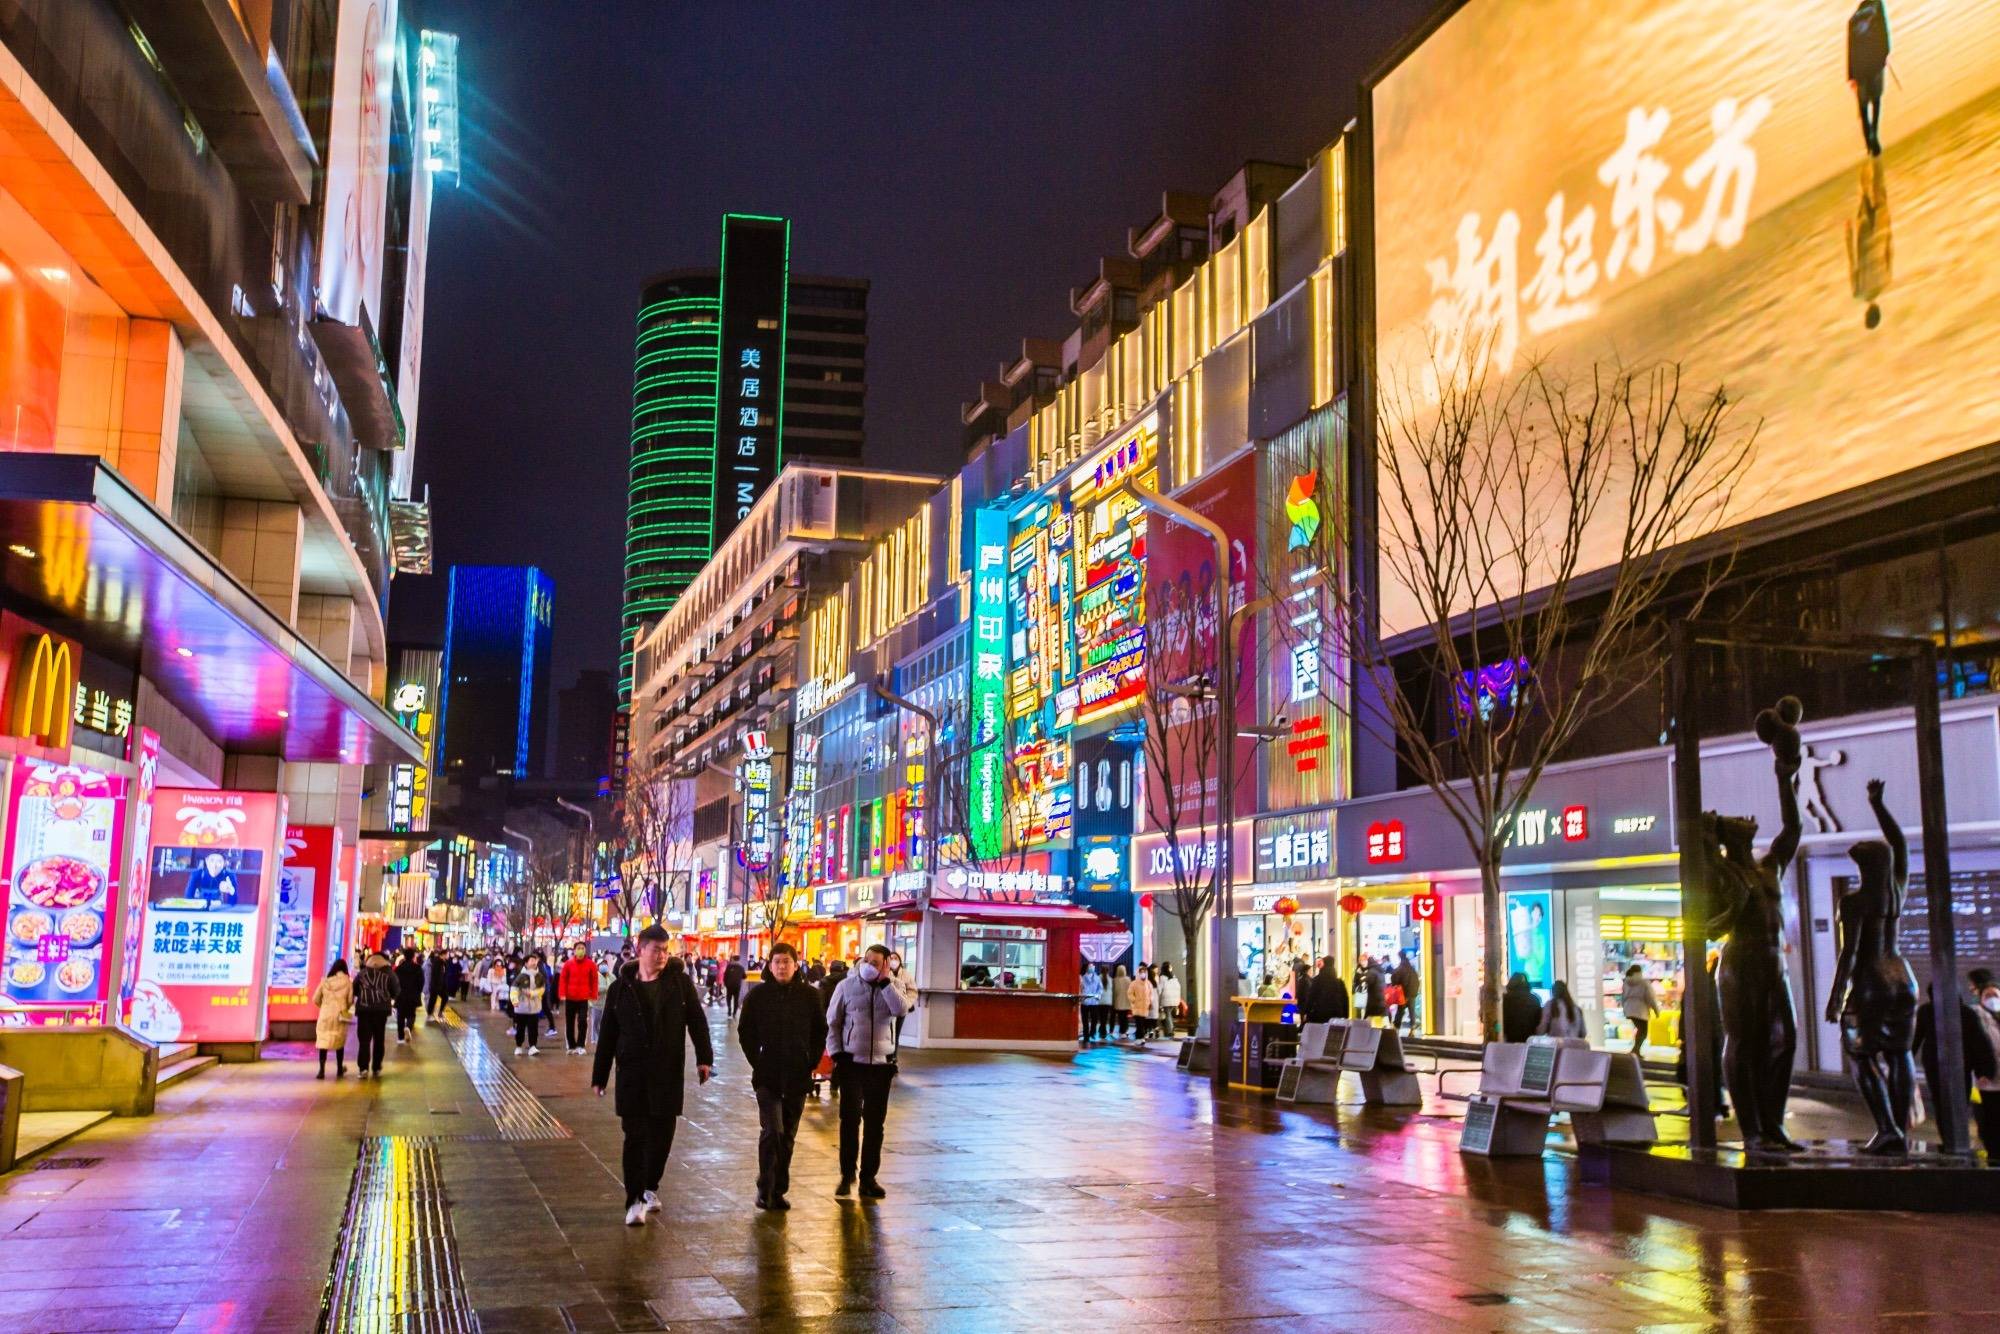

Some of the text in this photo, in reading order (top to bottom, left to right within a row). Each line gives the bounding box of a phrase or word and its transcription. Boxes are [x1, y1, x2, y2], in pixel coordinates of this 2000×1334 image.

[1425, 96, 1773, 378] 潮起东方
[738, 348, 761, 456] 美居酒店
[980, 752, 997, 824] Impression
[1149, 843, 1198, 875] JOSNY
[1258, 824, 1328, 870] 三唐百货
[153, 938, 242, 954] 就吃半天妖
[154, 921, 244, 937] 烤鱼不用挑
[1575, 905, 1596, 1011] WELCOME
